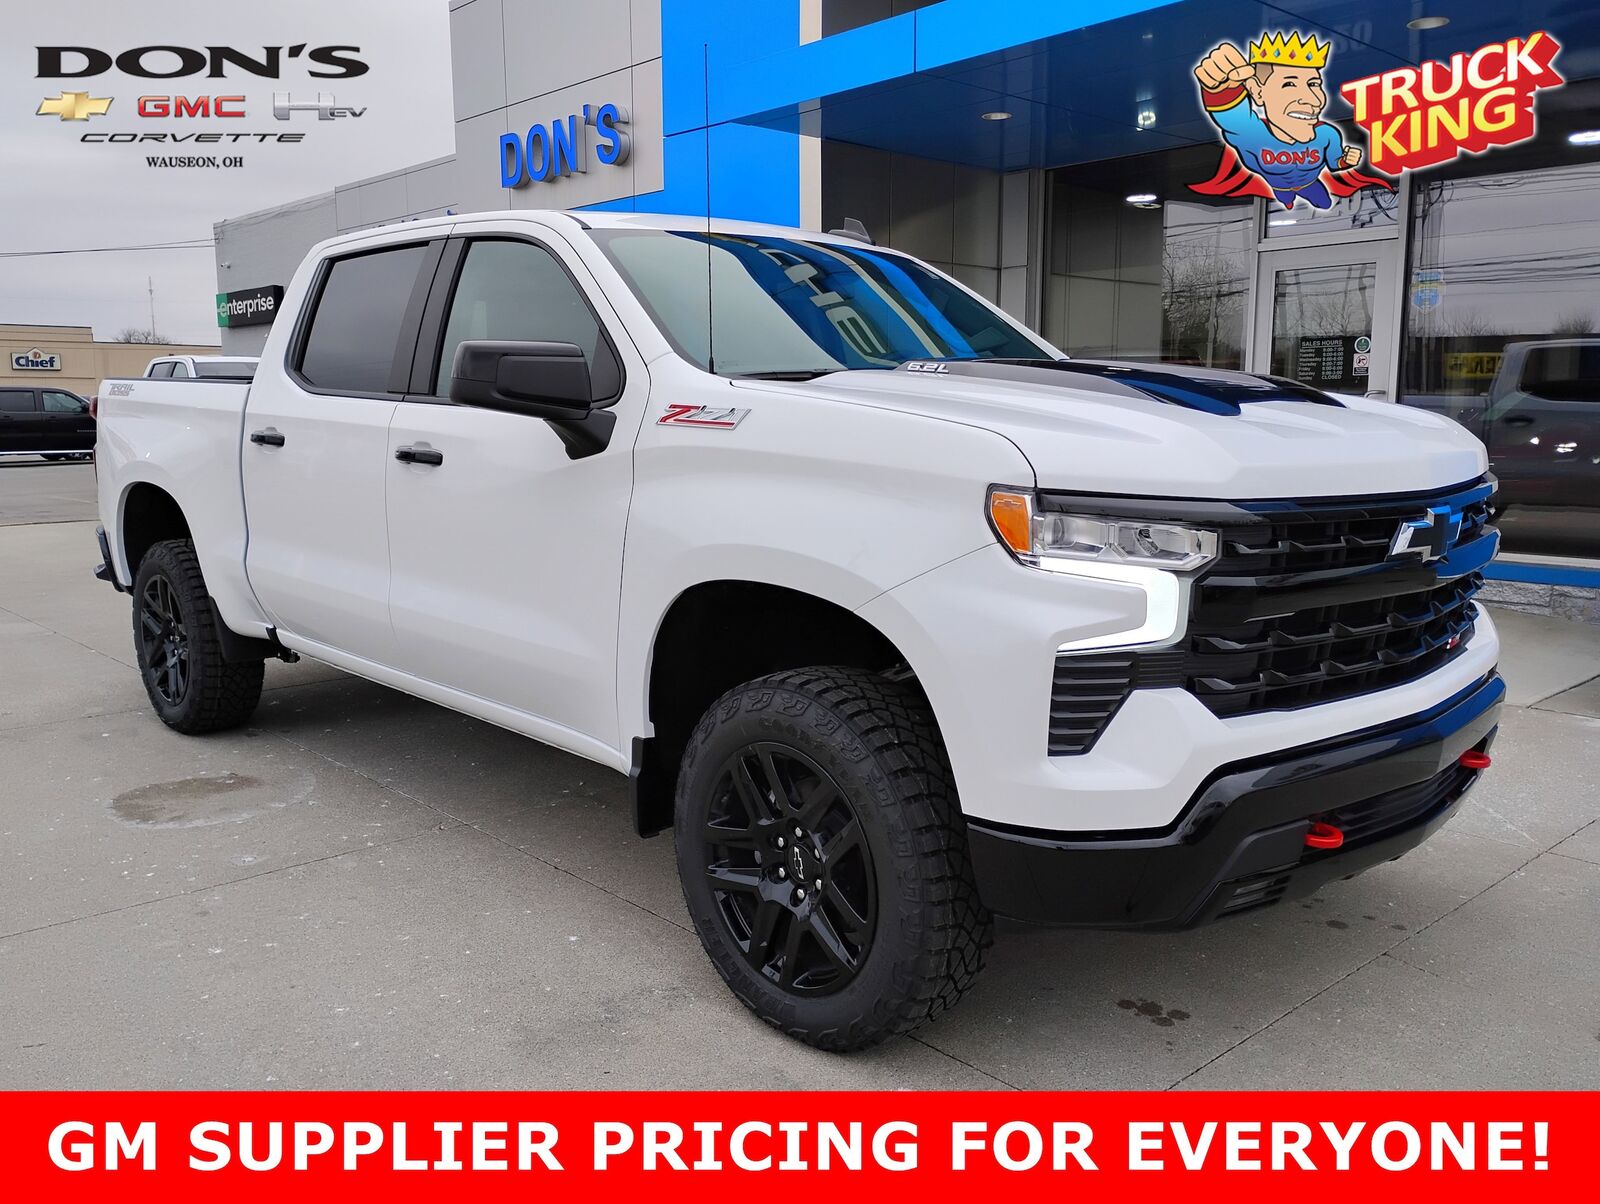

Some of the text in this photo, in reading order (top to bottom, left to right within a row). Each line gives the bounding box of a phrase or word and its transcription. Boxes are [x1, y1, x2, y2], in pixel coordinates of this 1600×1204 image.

[499, 103, 630, 189] DON'S
[220, 293, 274, 318] enterprise
[15, 356, 55, 368] Chief
[656, 404, 752, 431] Z71
